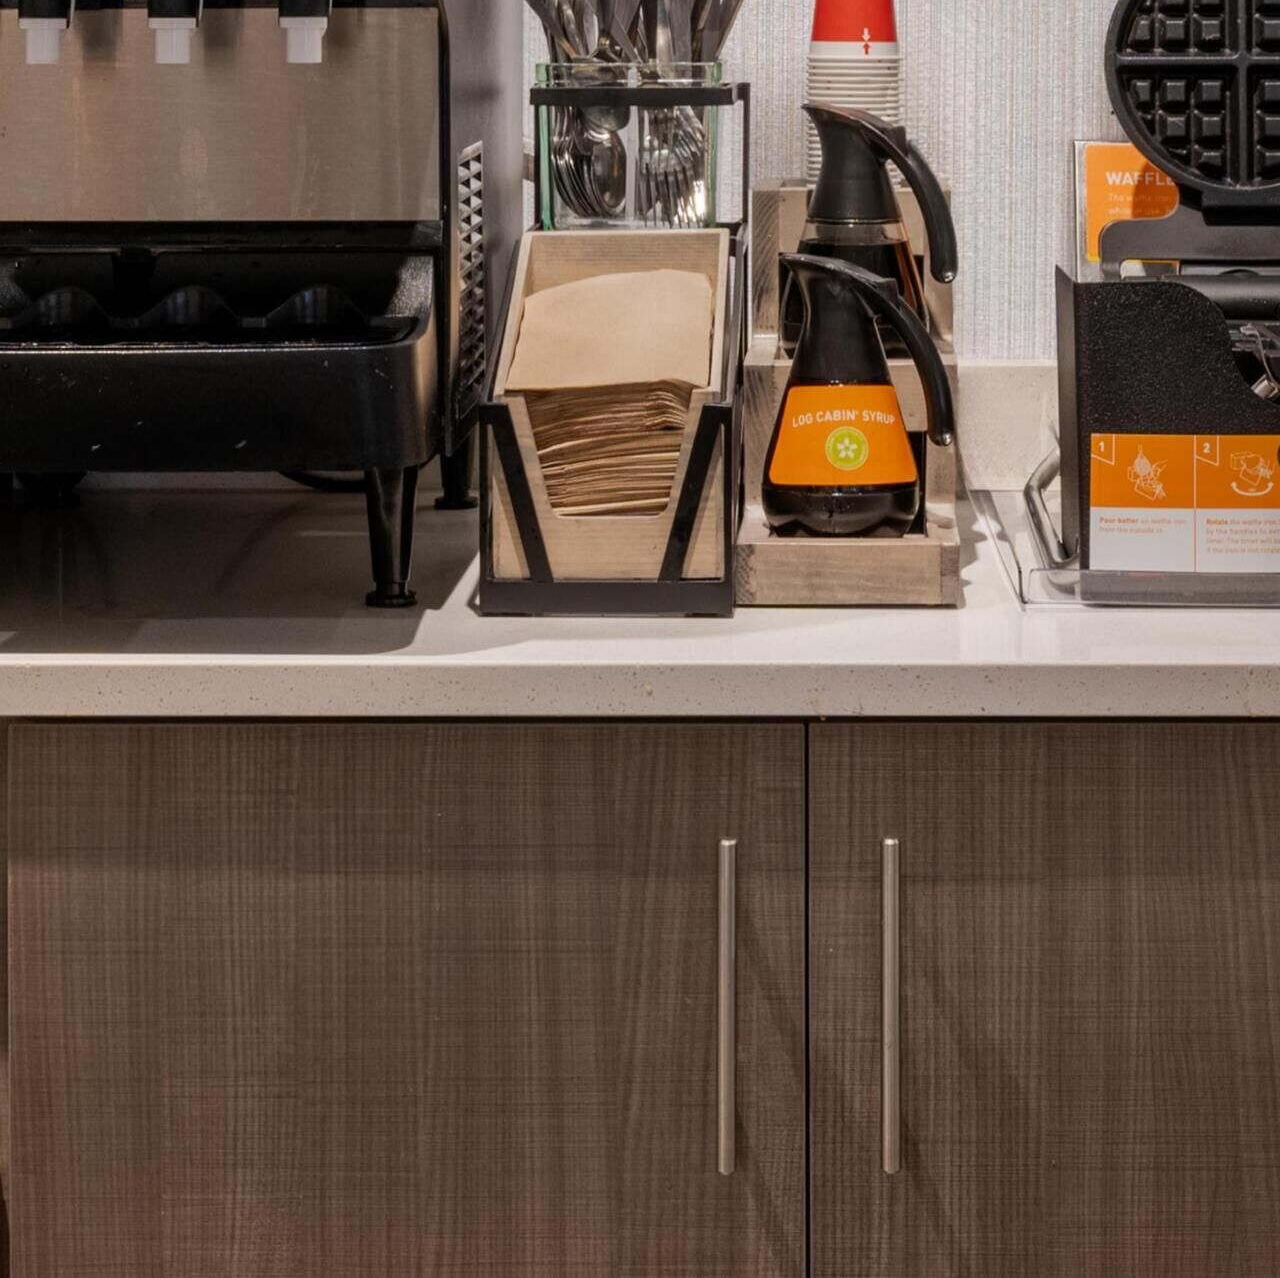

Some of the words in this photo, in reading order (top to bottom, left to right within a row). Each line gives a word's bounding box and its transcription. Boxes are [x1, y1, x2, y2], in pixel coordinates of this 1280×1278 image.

[792, 413, 814, 428] LOG
[862, 409, 896, 426] SYRUP
[1098, 441, 1105, 453] 1
[1202, 442, 1211, 454] 2
